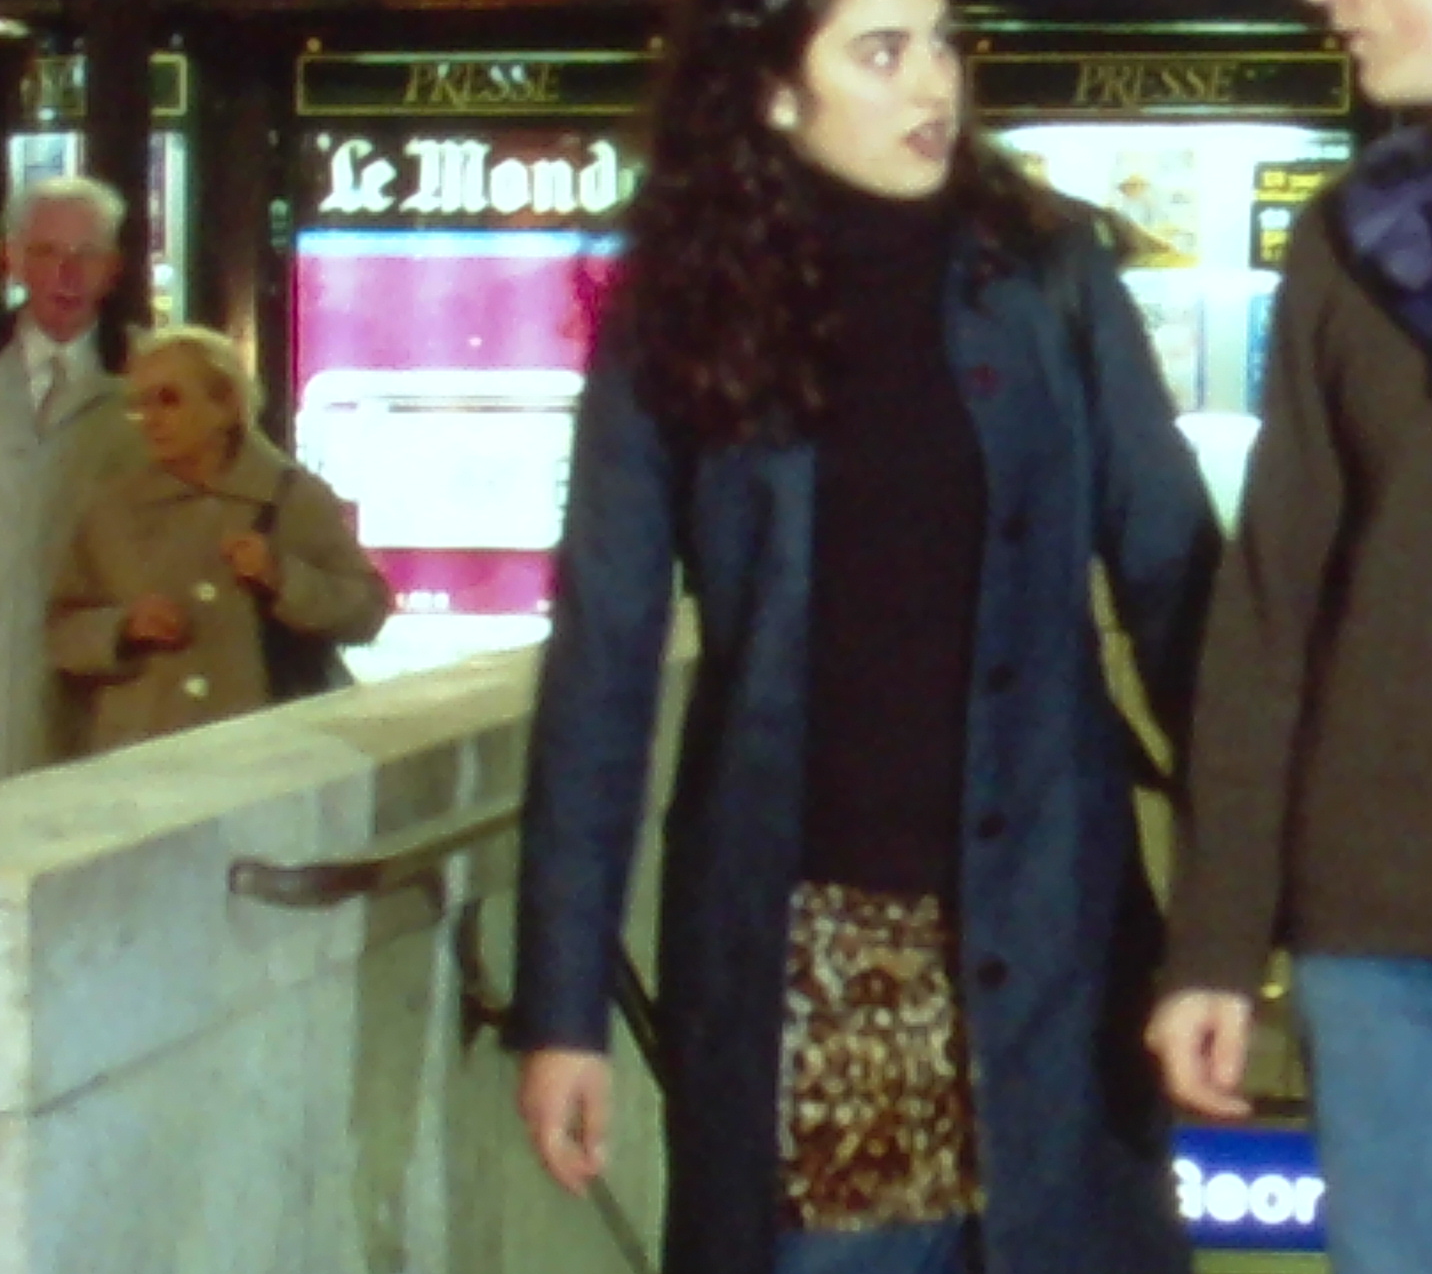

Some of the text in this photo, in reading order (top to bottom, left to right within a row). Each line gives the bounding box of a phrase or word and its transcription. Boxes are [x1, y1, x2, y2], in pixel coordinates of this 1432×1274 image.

[403, 63, 561, 109] PRESSE
[1076, 63, 1231, 107] PRESSE
[319, 138, 397, 214] Le
